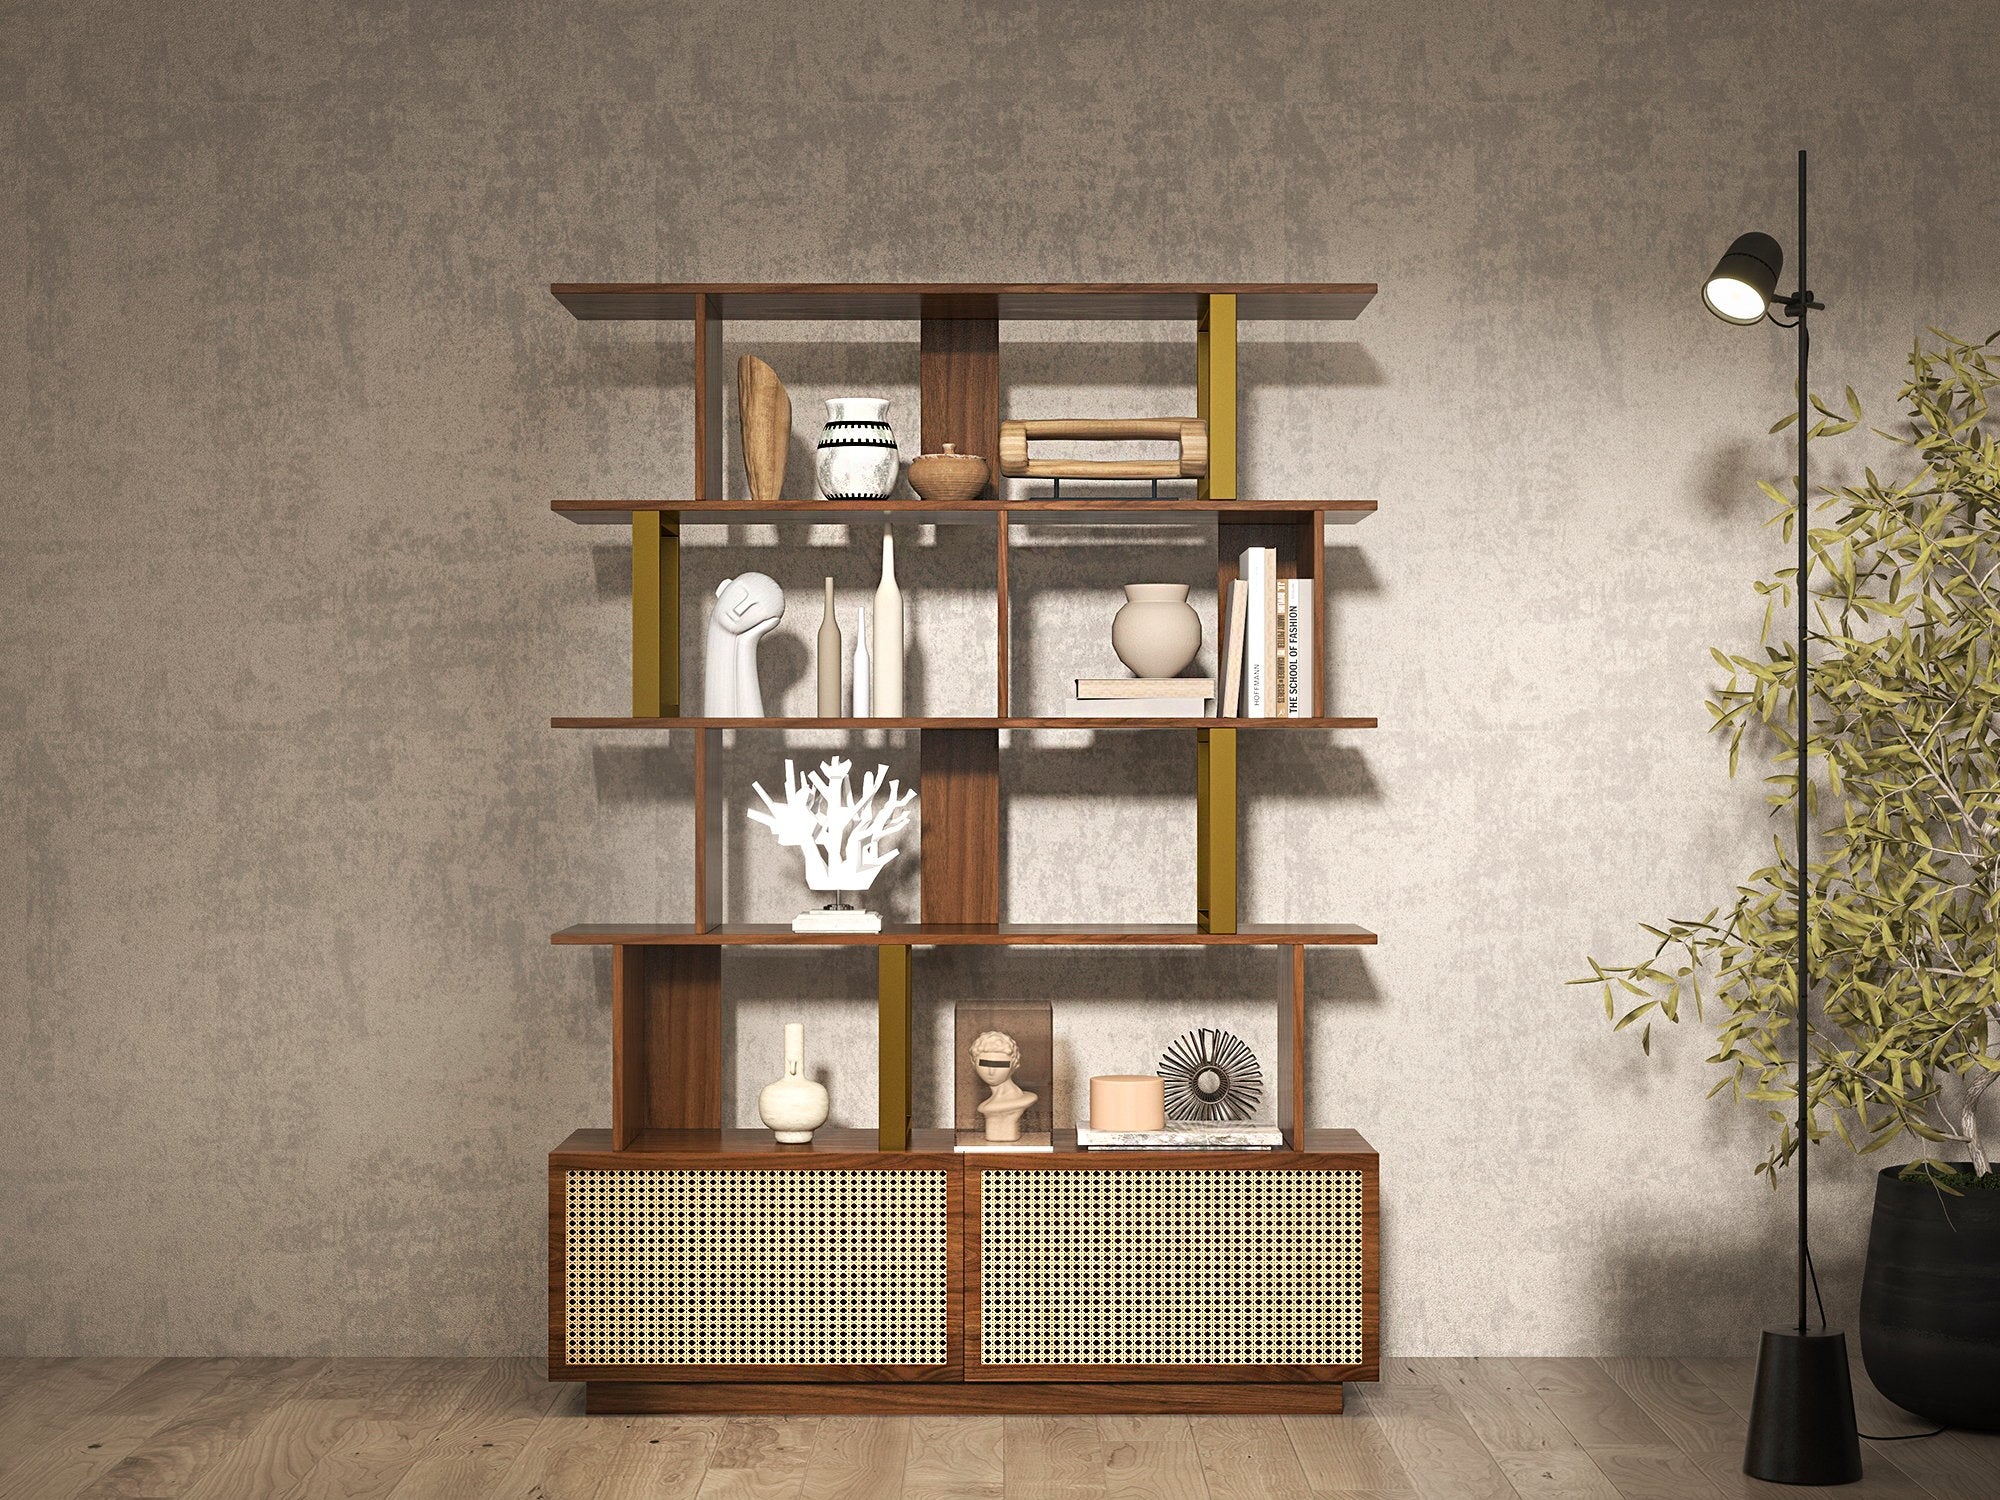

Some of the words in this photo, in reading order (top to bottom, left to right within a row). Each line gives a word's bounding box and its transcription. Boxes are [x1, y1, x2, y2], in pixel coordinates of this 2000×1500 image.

[1289, 605, 1298, 644] FASHION
[1277, 631, 1285, 648] POTTER
[1289, 646, 1298, 657] OF
[1289, 660, 1298, 694] SCHOOL
[1289, 697, 1298, 713] THE
